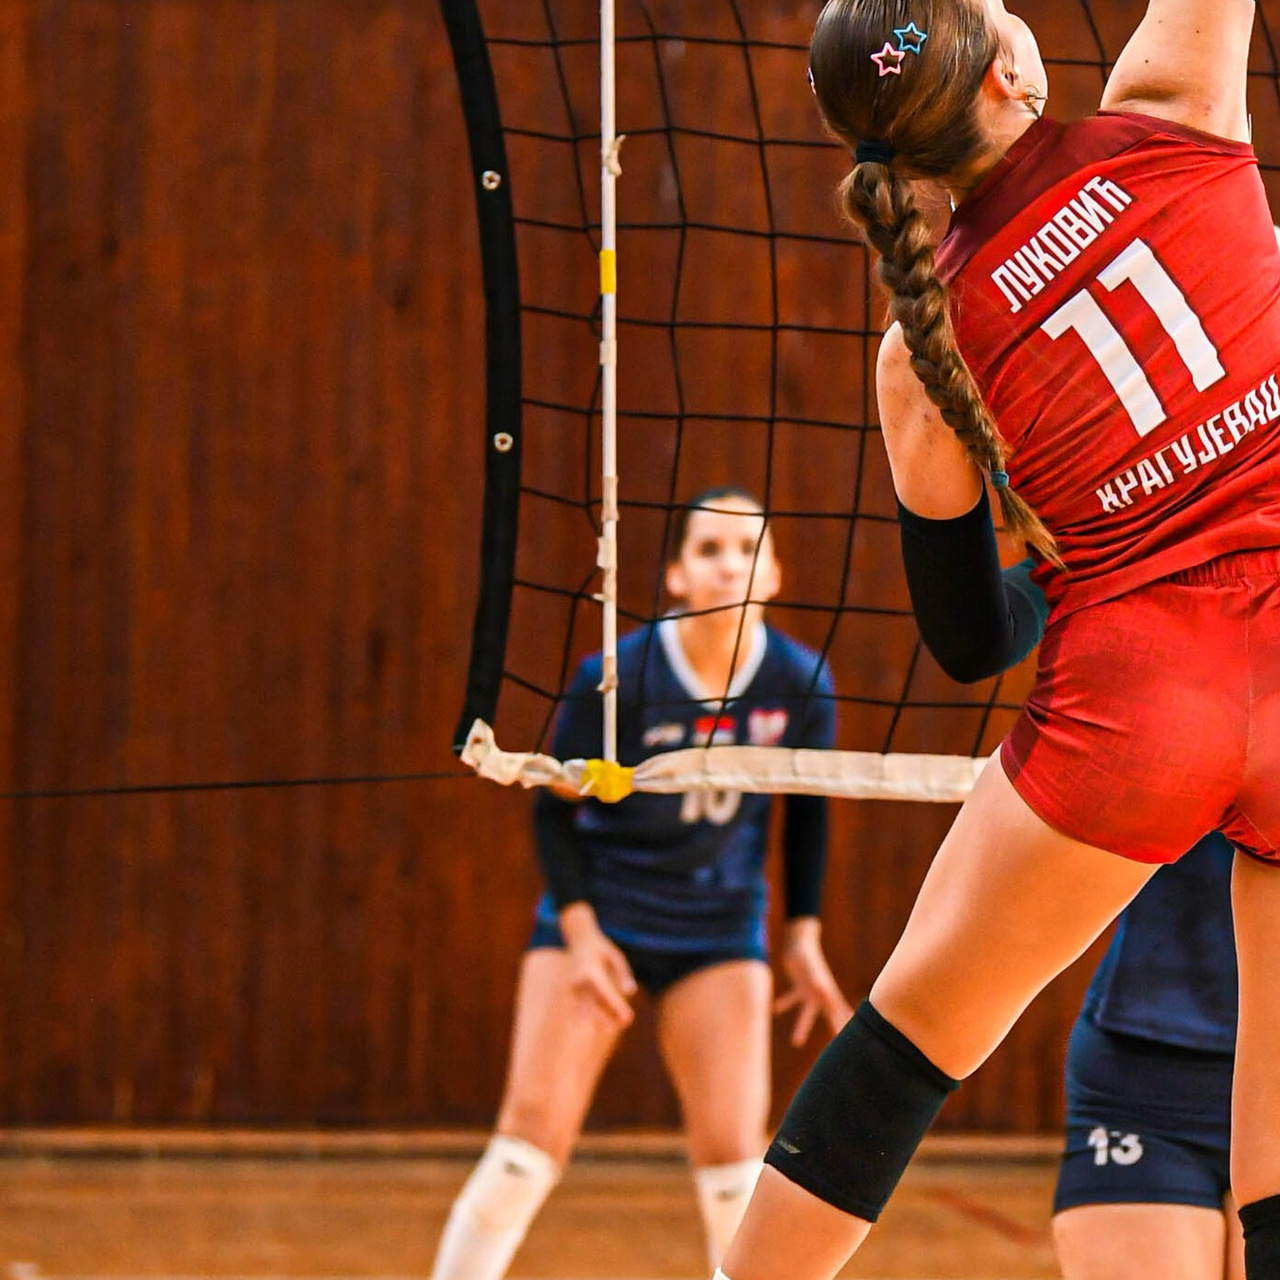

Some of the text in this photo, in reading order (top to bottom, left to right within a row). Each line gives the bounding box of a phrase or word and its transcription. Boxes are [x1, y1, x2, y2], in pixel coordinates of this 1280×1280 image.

[991, 176, 1133, 313] ЛУКОВИЋ
[1041, 238, 1226, 438] 11
[1088, 1126, 1144, 1166] 13
